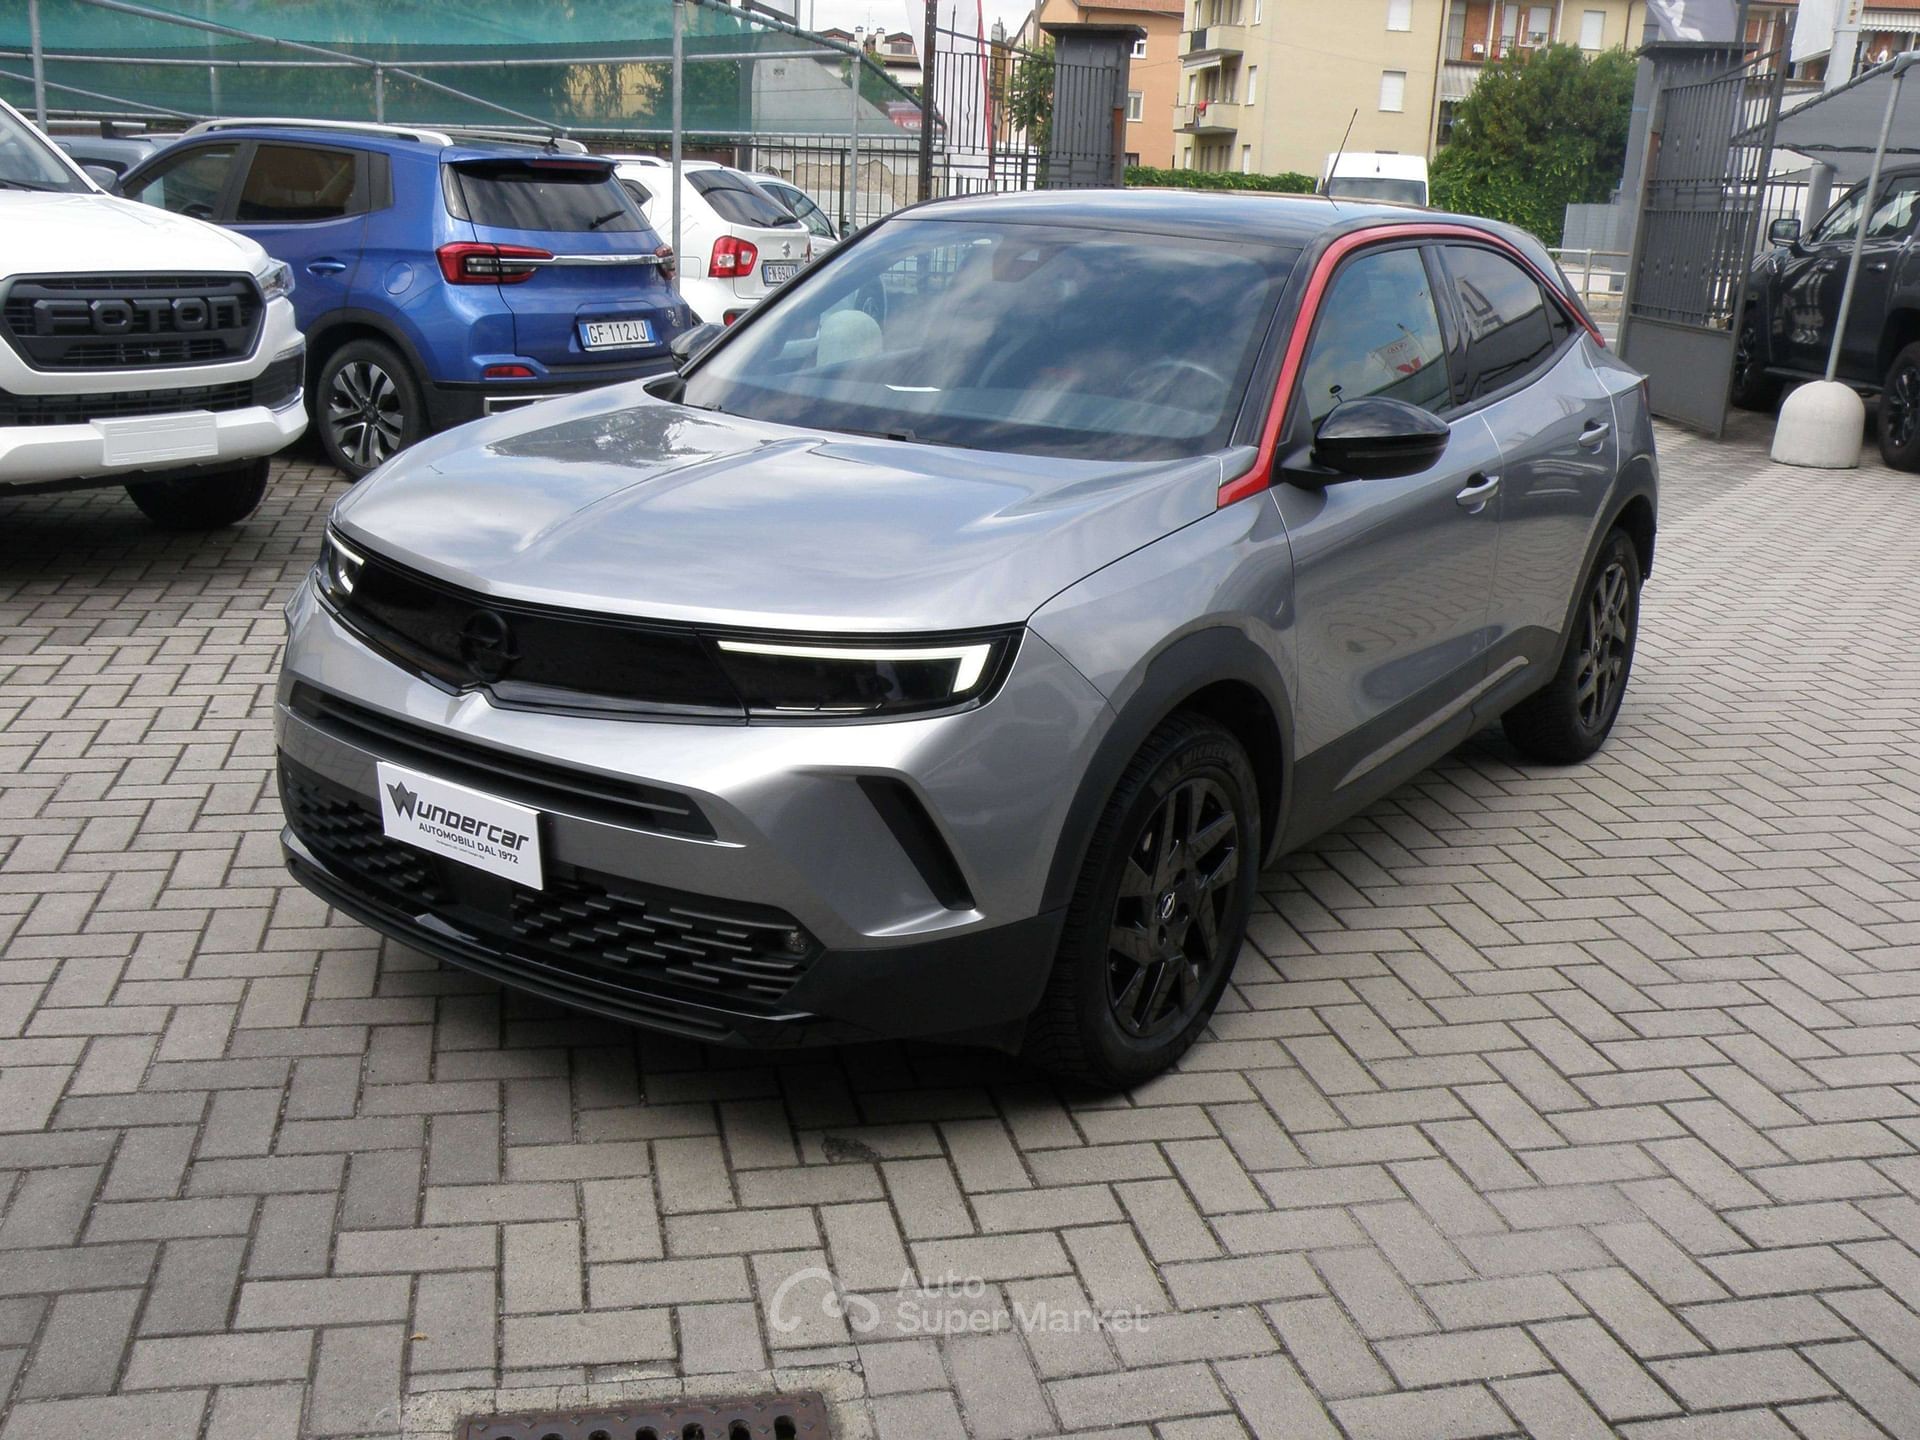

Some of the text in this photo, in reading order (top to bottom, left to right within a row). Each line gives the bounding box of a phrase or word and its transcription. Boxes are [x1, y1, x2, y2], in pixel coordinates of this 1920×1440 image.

[418, 822, 475, 849] AUTOMOBILI
[477, 842, 497, 857] DAL
[498, 849, 519, 864] 1972
